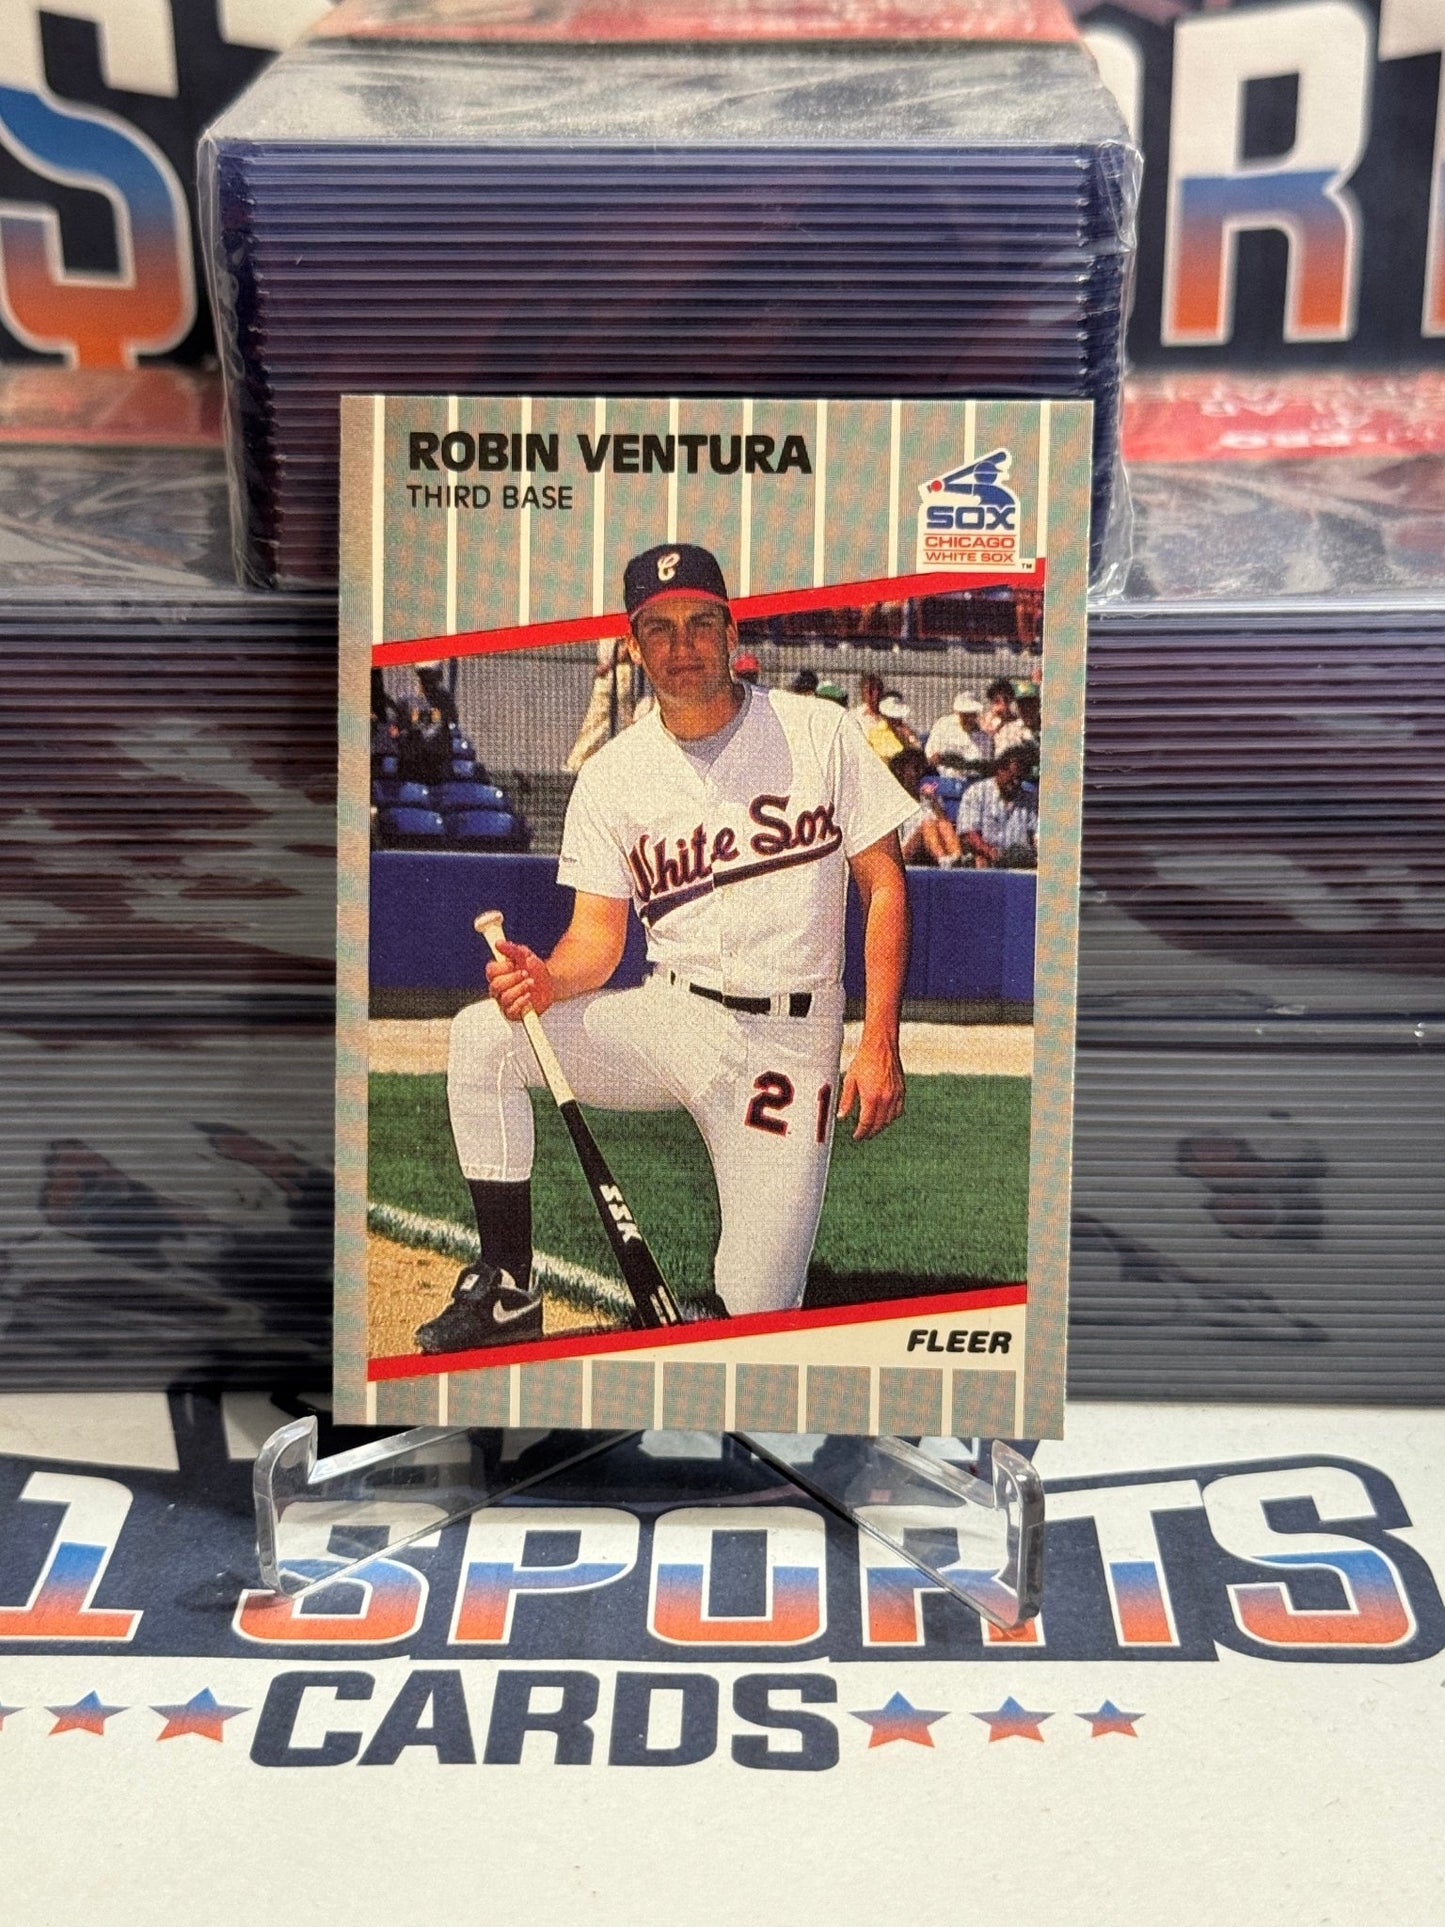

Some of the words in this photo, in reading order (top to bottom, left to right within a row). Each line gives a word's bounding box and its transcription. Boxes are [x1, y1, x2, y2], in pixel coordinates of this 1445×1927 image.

[408, 430, 559, 473] ROBIN
[576, 433, 813, 475] VENTURA
[407, 485, 491, 510] THIRD
[502, 485, 573, 511] BASE
[926, 505, 1016, 531] SOX
[924, 536, 1016, 549] CHICAGO
[925, 551, 977, 562] WHITE
[980, 552, 1014, 563] SOX
[749, 793, 842, 856] Sox
[744, 1070, 833, 1144] 21
[906, 1328, 1013, 1354] FLEER
[231, 1465, 1418, 1648] SPORTS
[249, 1668, 840, 1772] CARDS
